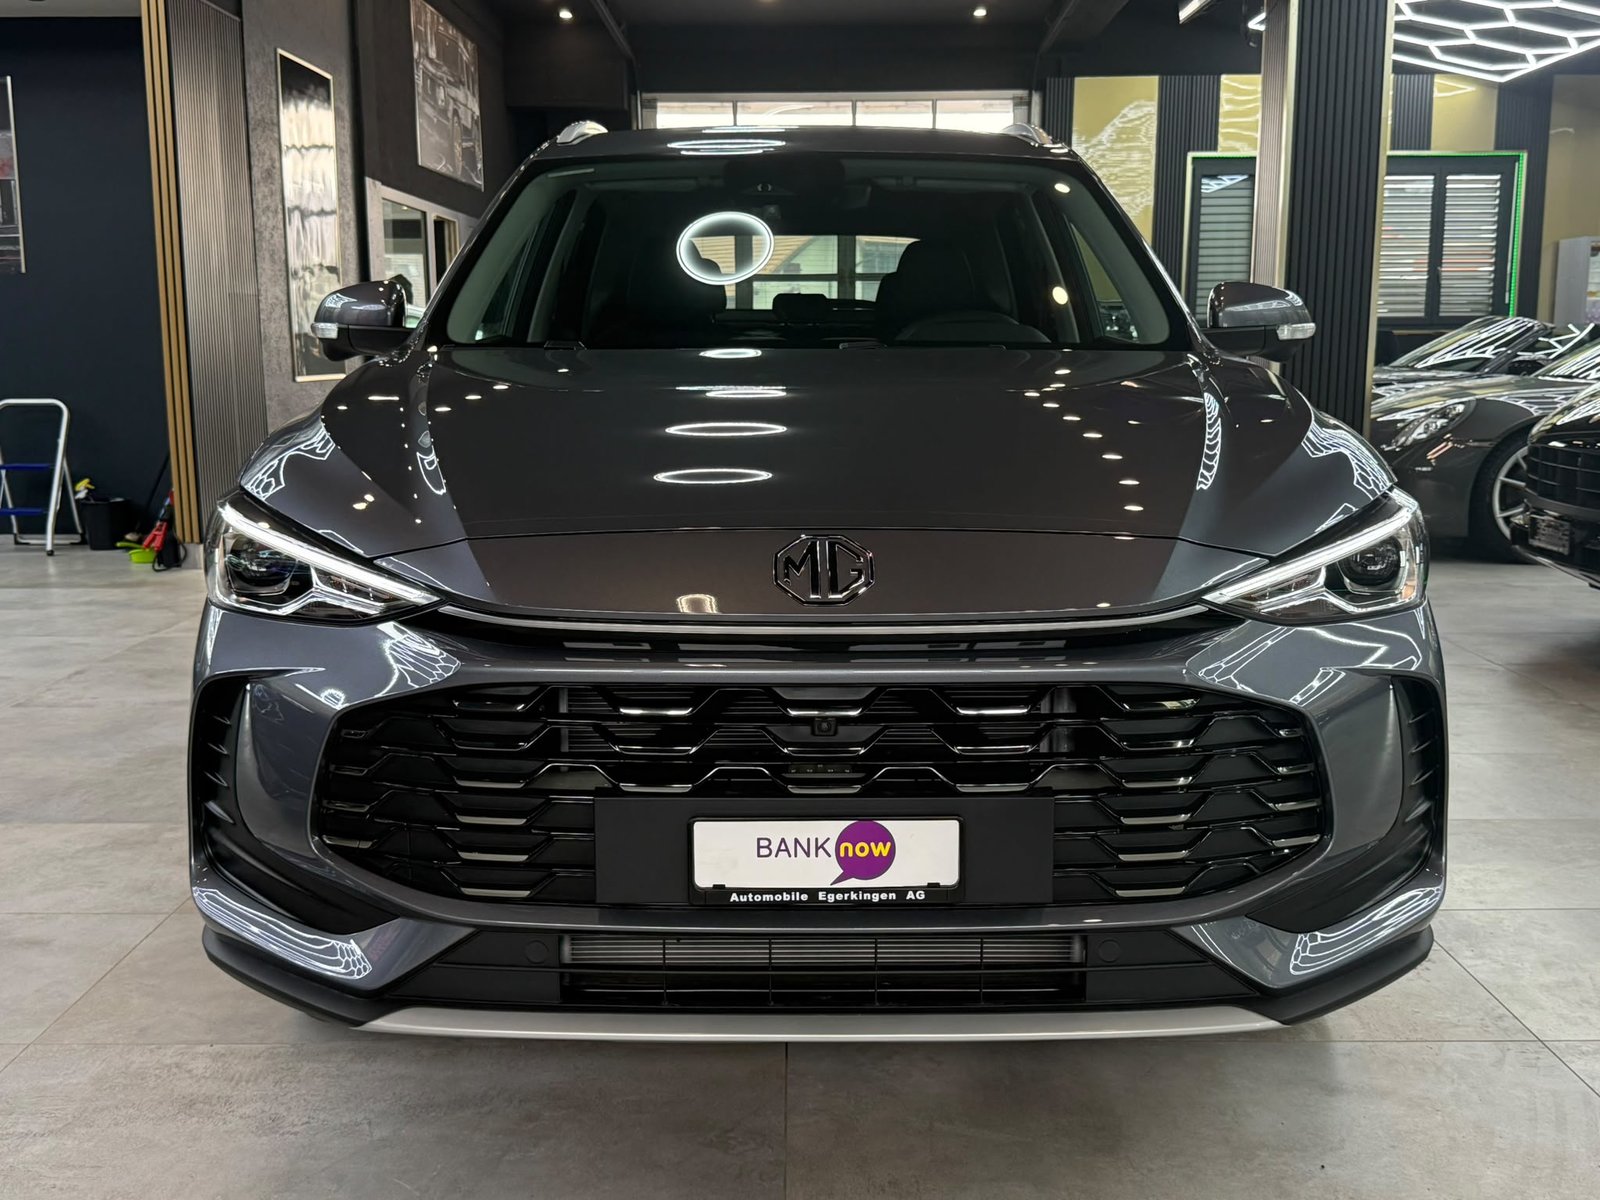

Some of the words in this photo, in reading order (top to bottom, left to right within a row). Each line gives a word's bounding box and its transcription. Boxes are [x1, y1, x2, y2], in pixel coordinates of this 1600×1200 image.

[783, 539, 865, 599] MG
[756, 837, 832, 858] BANK
[839, 841, 891, 858] now
[729, 891, 809, 902] Automobile
[818, 890, 896, 903] Egerkingen
[906, 890, 926, 900] AG
